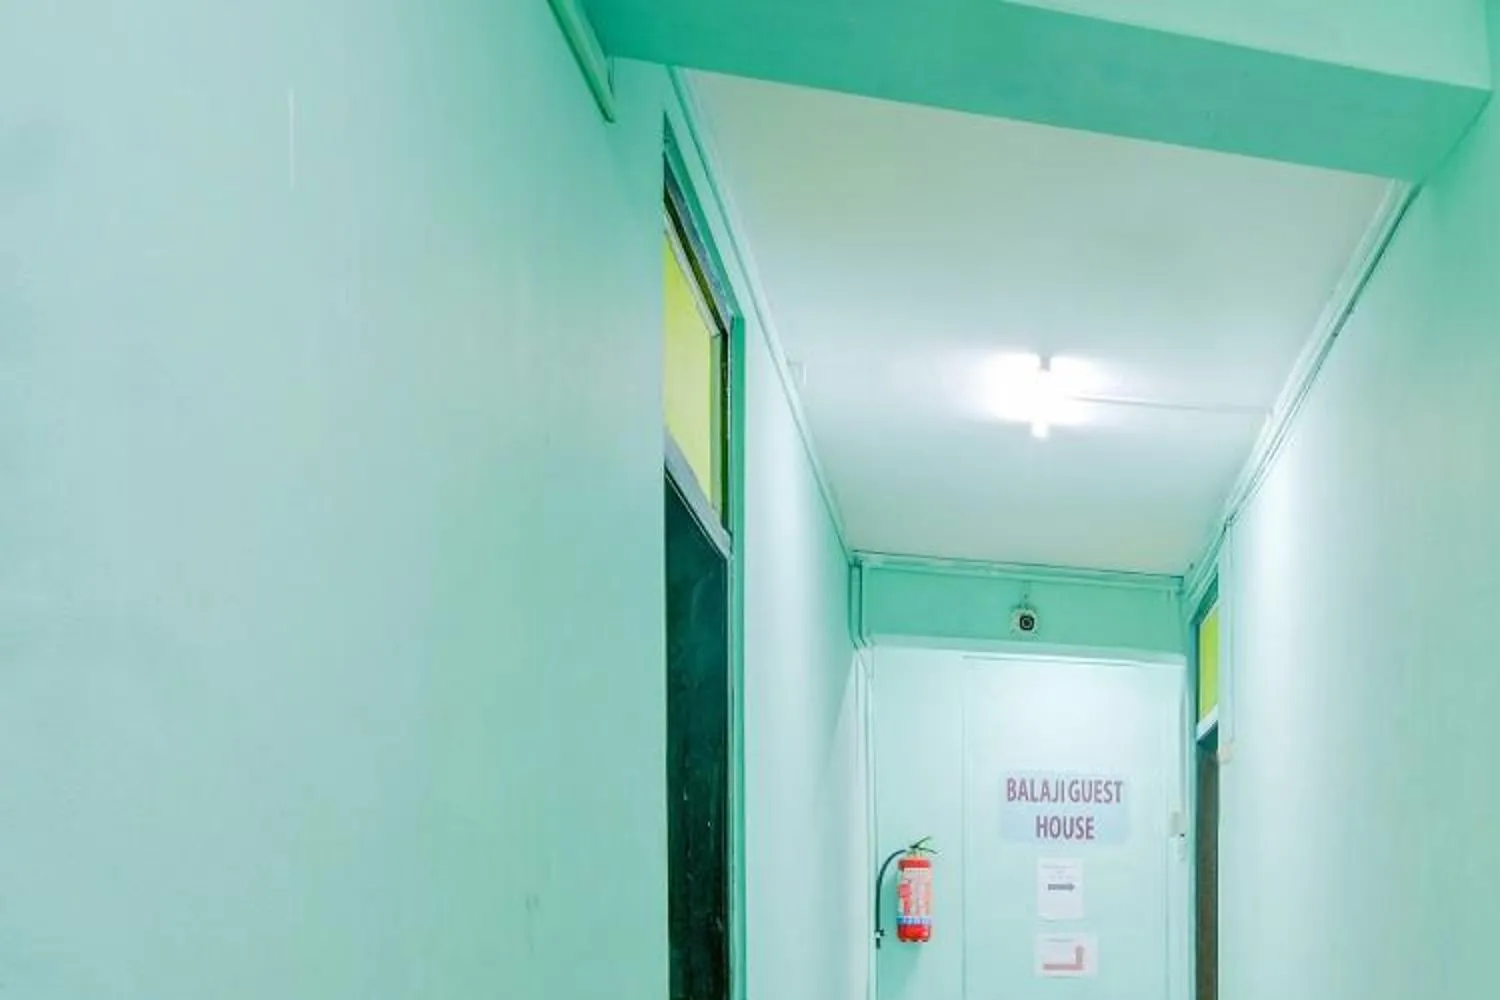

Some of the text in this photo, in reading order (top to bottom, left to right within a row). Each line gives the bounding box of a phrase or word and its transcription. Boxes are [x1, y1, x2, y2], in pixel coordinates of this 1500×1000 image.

[1006, 777, 1124, 803] BALAJI GUEST
[1035, 815, 1095, 839] HOUSE
